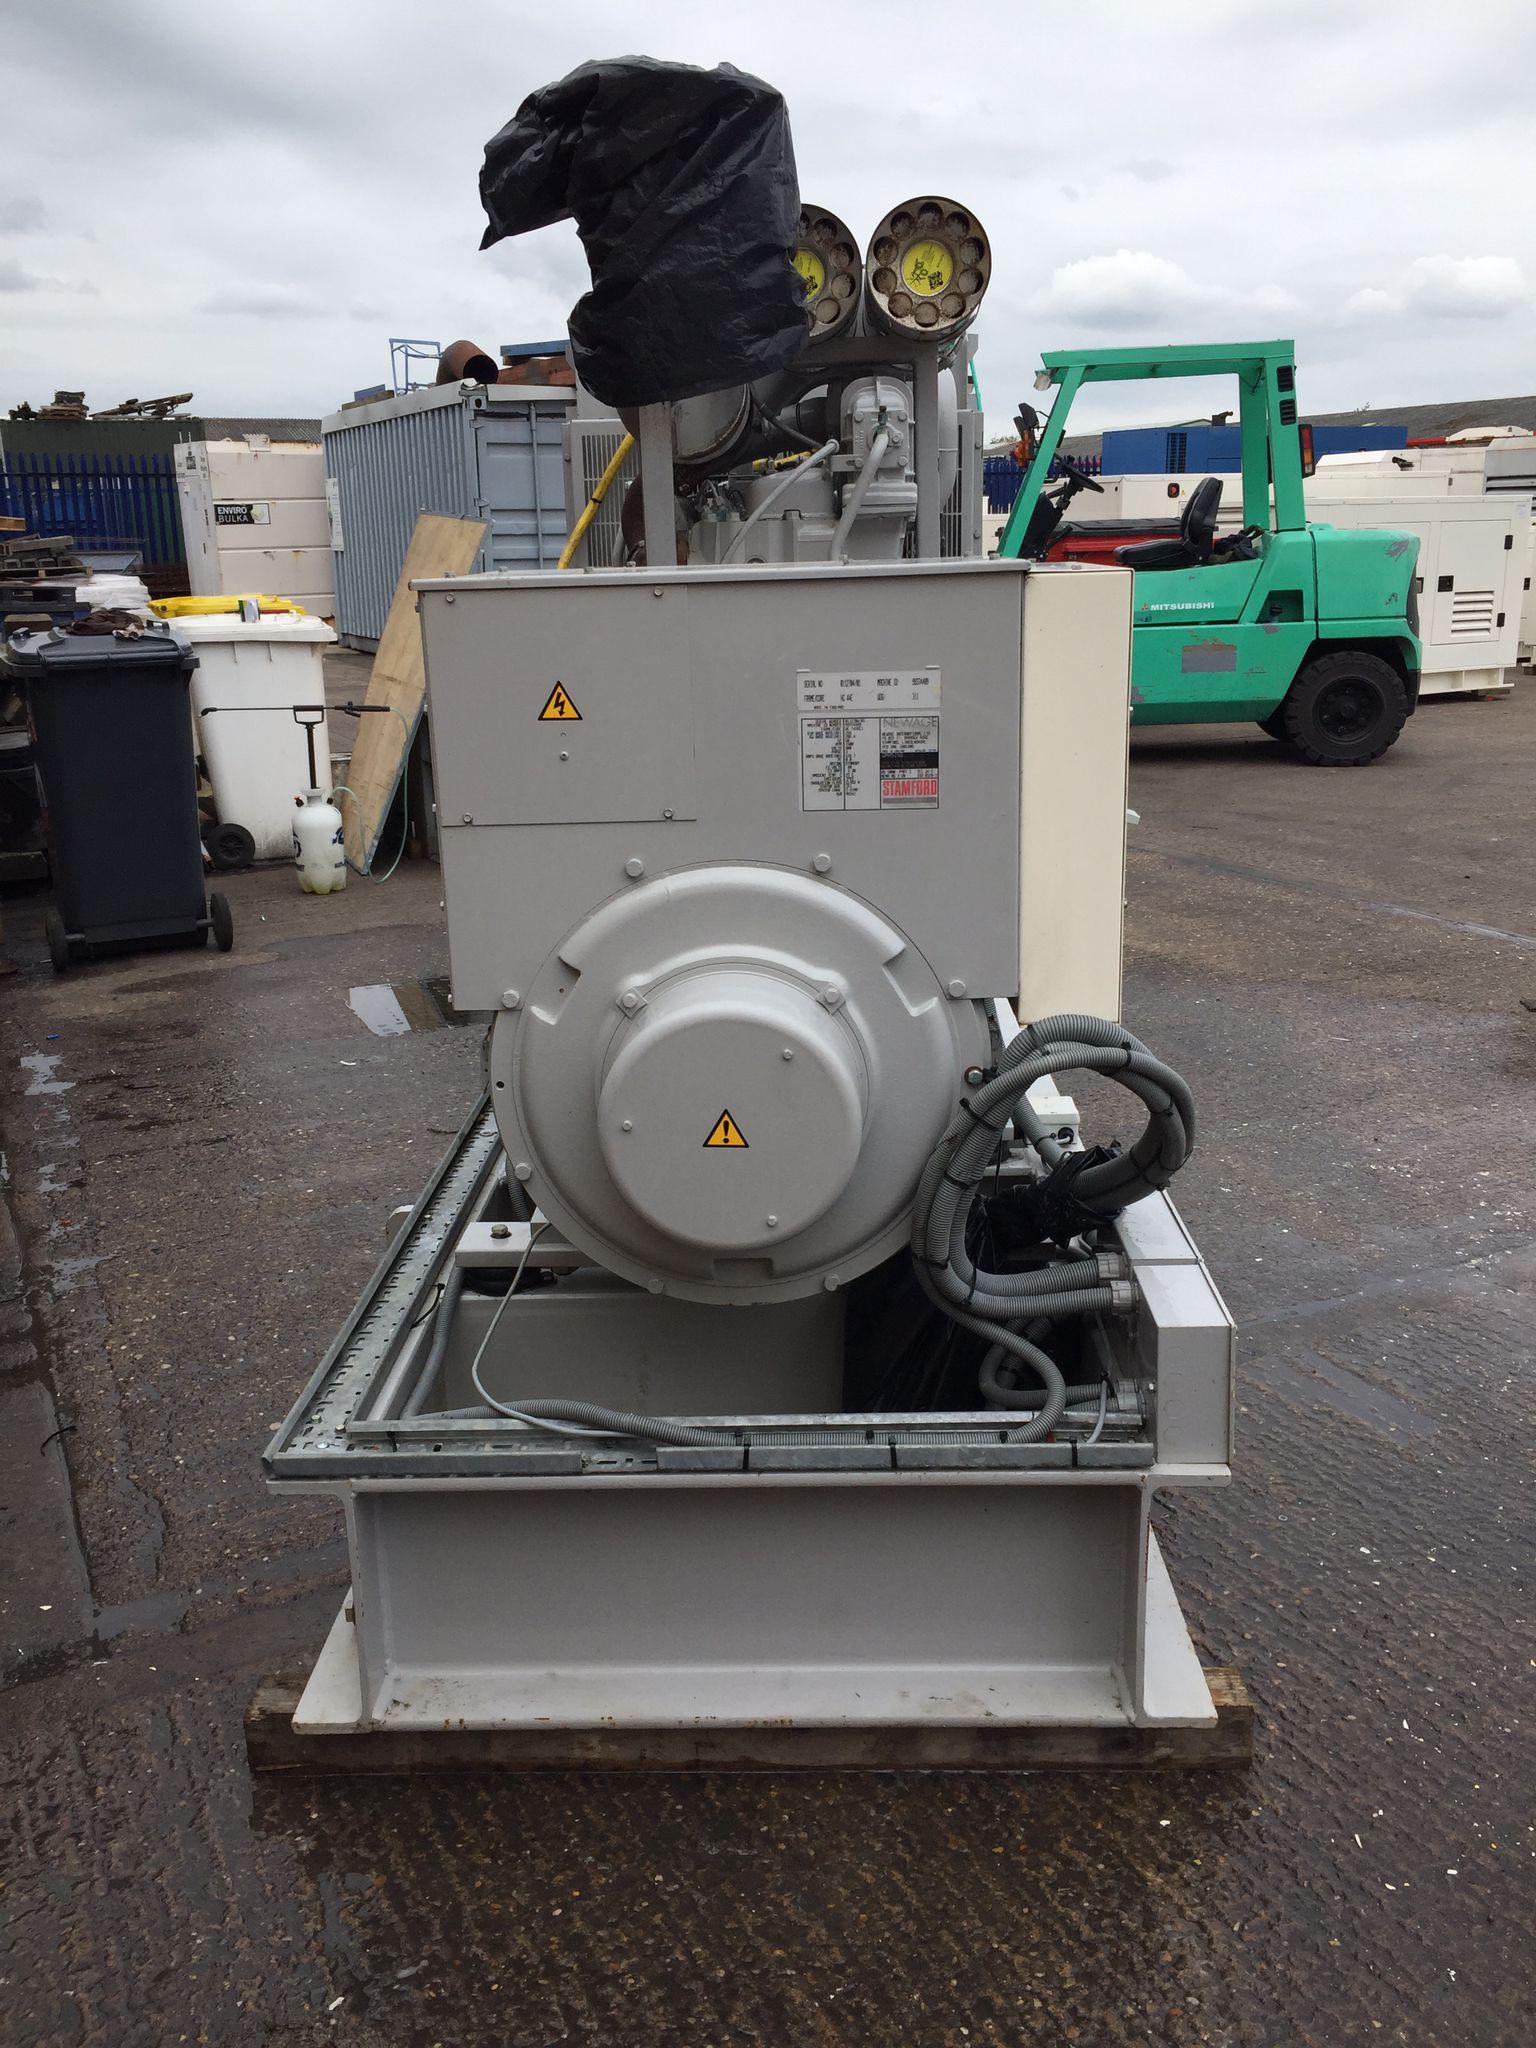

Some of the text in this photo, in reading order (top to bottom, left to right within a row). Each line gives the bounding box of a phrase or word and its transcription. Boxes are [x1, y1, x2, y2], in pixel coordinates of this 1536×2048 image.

[217, 506, 247, 515] ENVIRO
[218, 514, 249, 523] BULKA
[1150, 602, 1215, 611] MITSUBISHI
[883, 716, 938, 728] NEWAGE
[883, 780, 937, 796] STAMFORD
